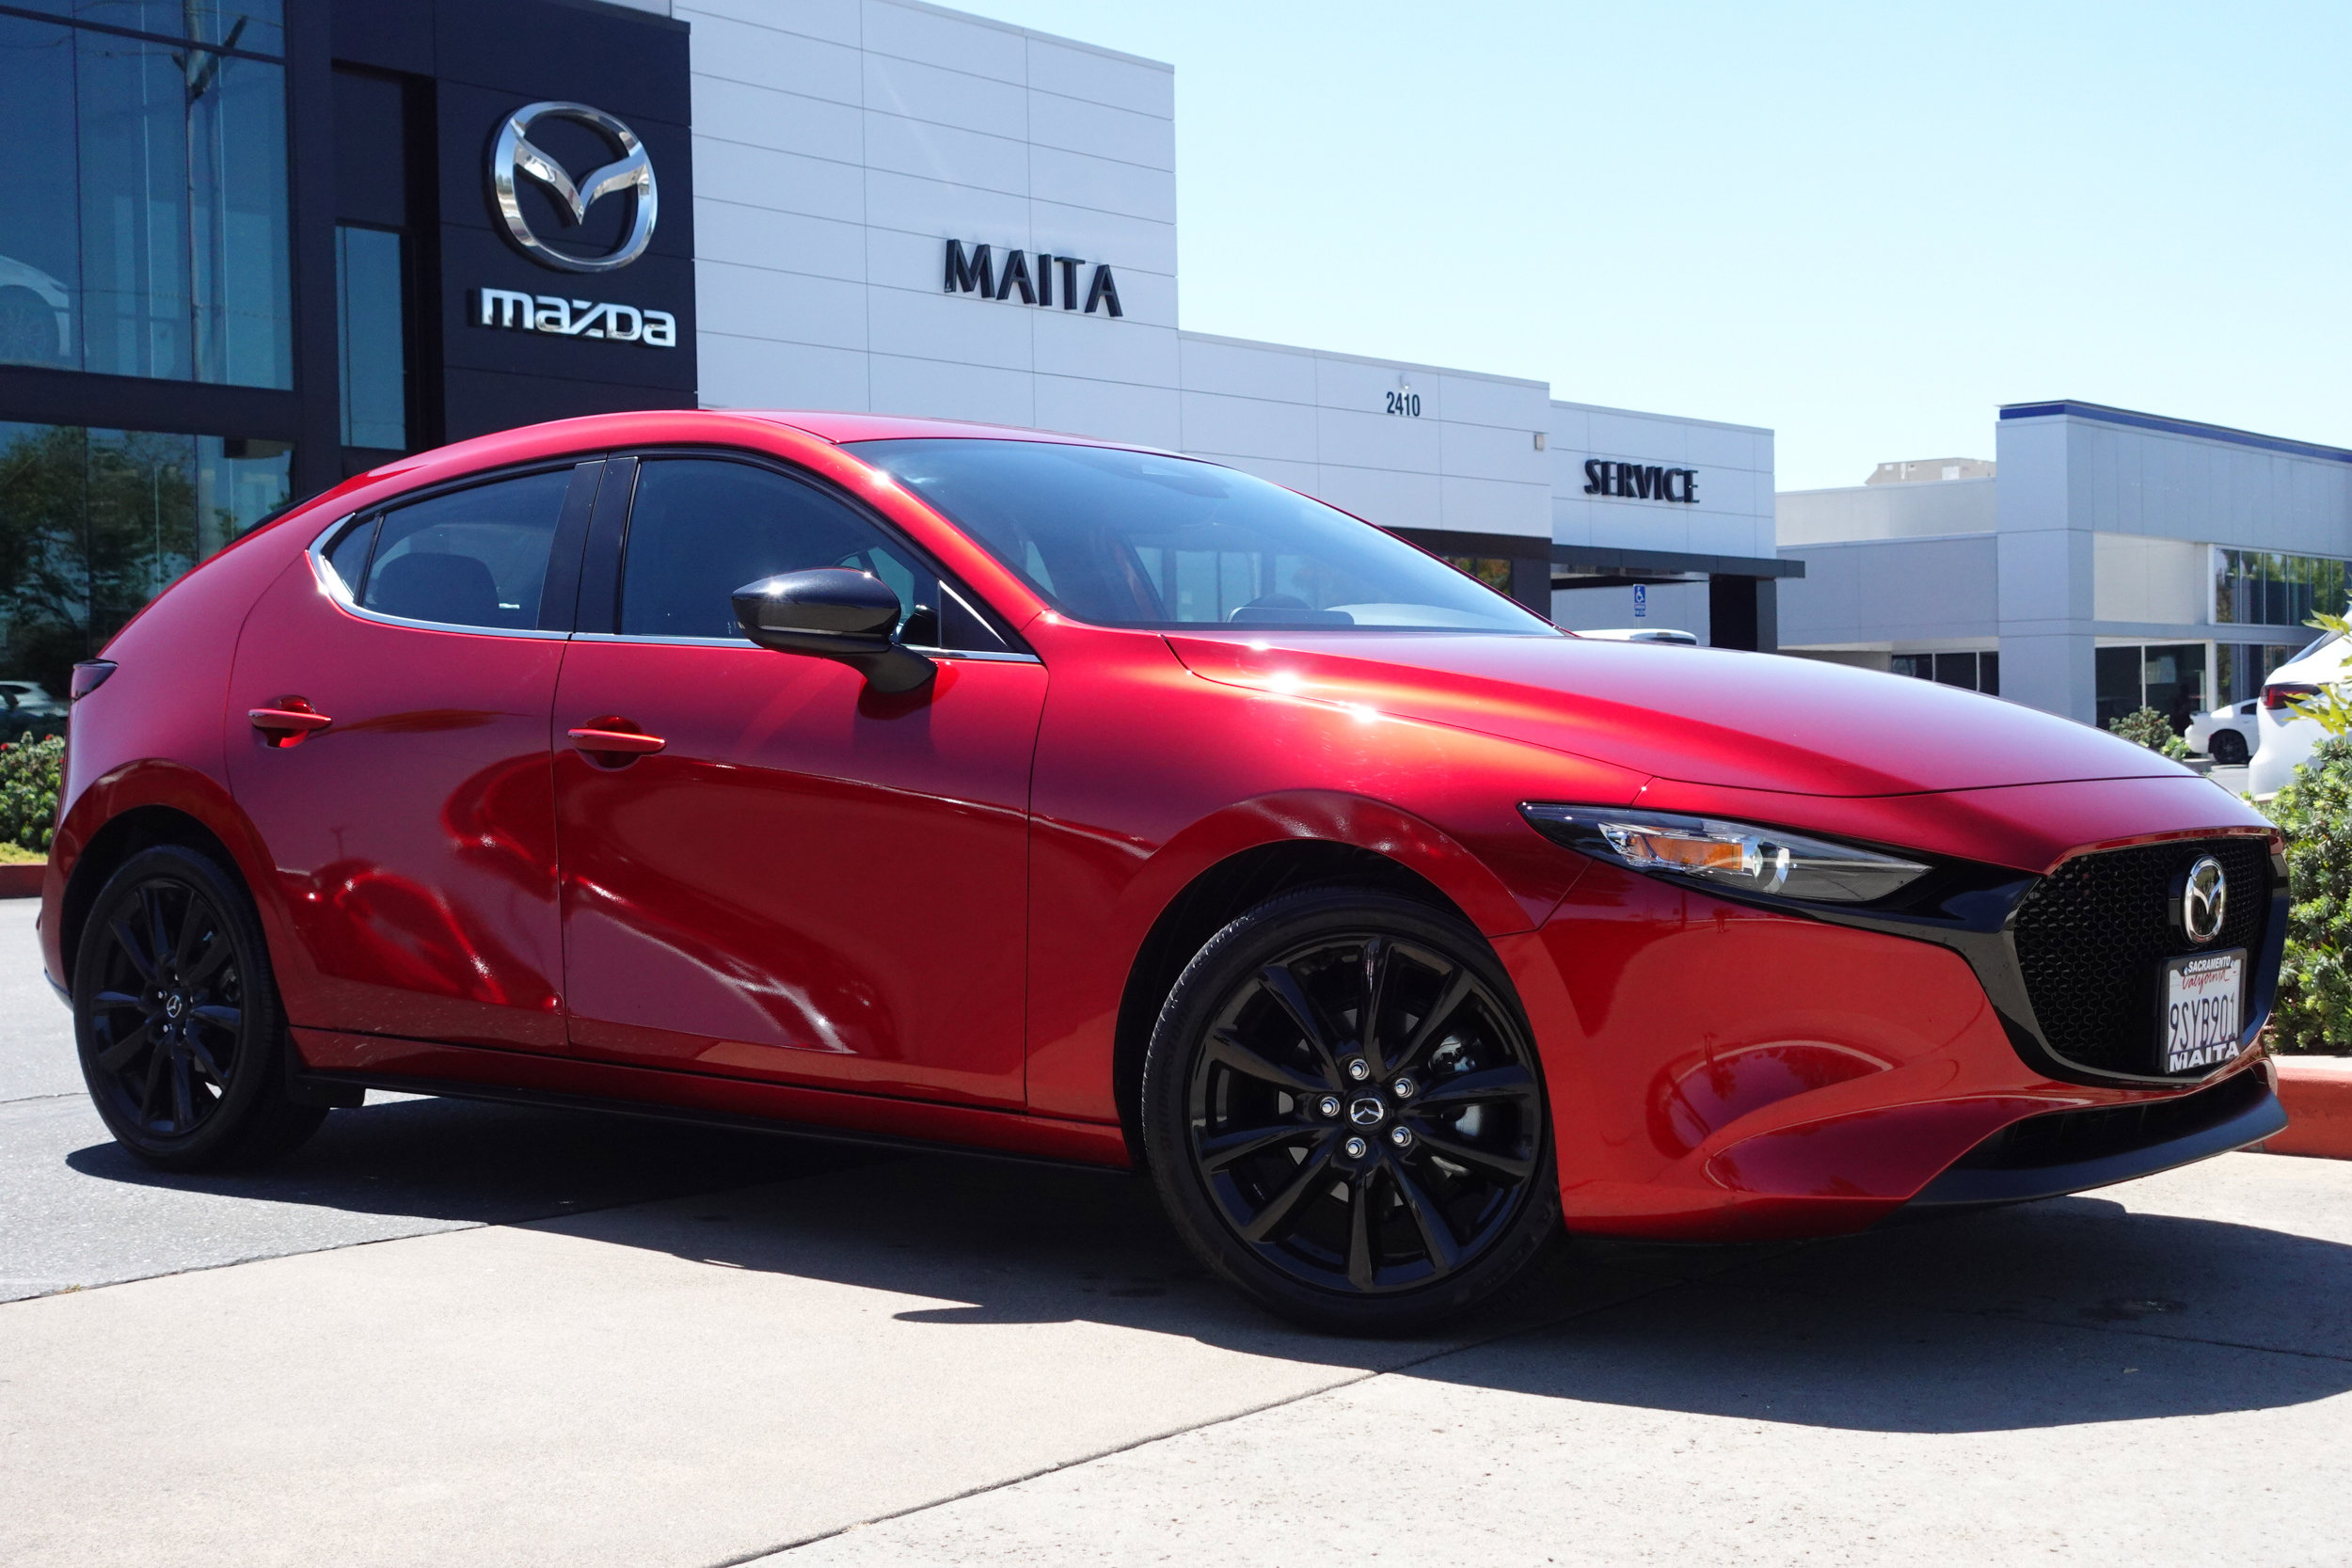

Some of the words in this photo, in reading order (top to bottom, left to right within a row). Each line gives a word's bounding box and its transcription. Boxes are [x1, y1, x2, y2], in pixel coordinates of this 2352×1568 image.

[944, 238, 1123, 317] MAITA
[1386, 390, 1421, 417] 2410
[1583, 458, 1700, 503] SERVICE
[2187, 956, 2231, 973] SACRAMENTO
[2182, 970, 2230, 994] California
[2169, 993, 2235, 1053] 9SYB901
[2169, 1040, 2240, 1072] MAITA
